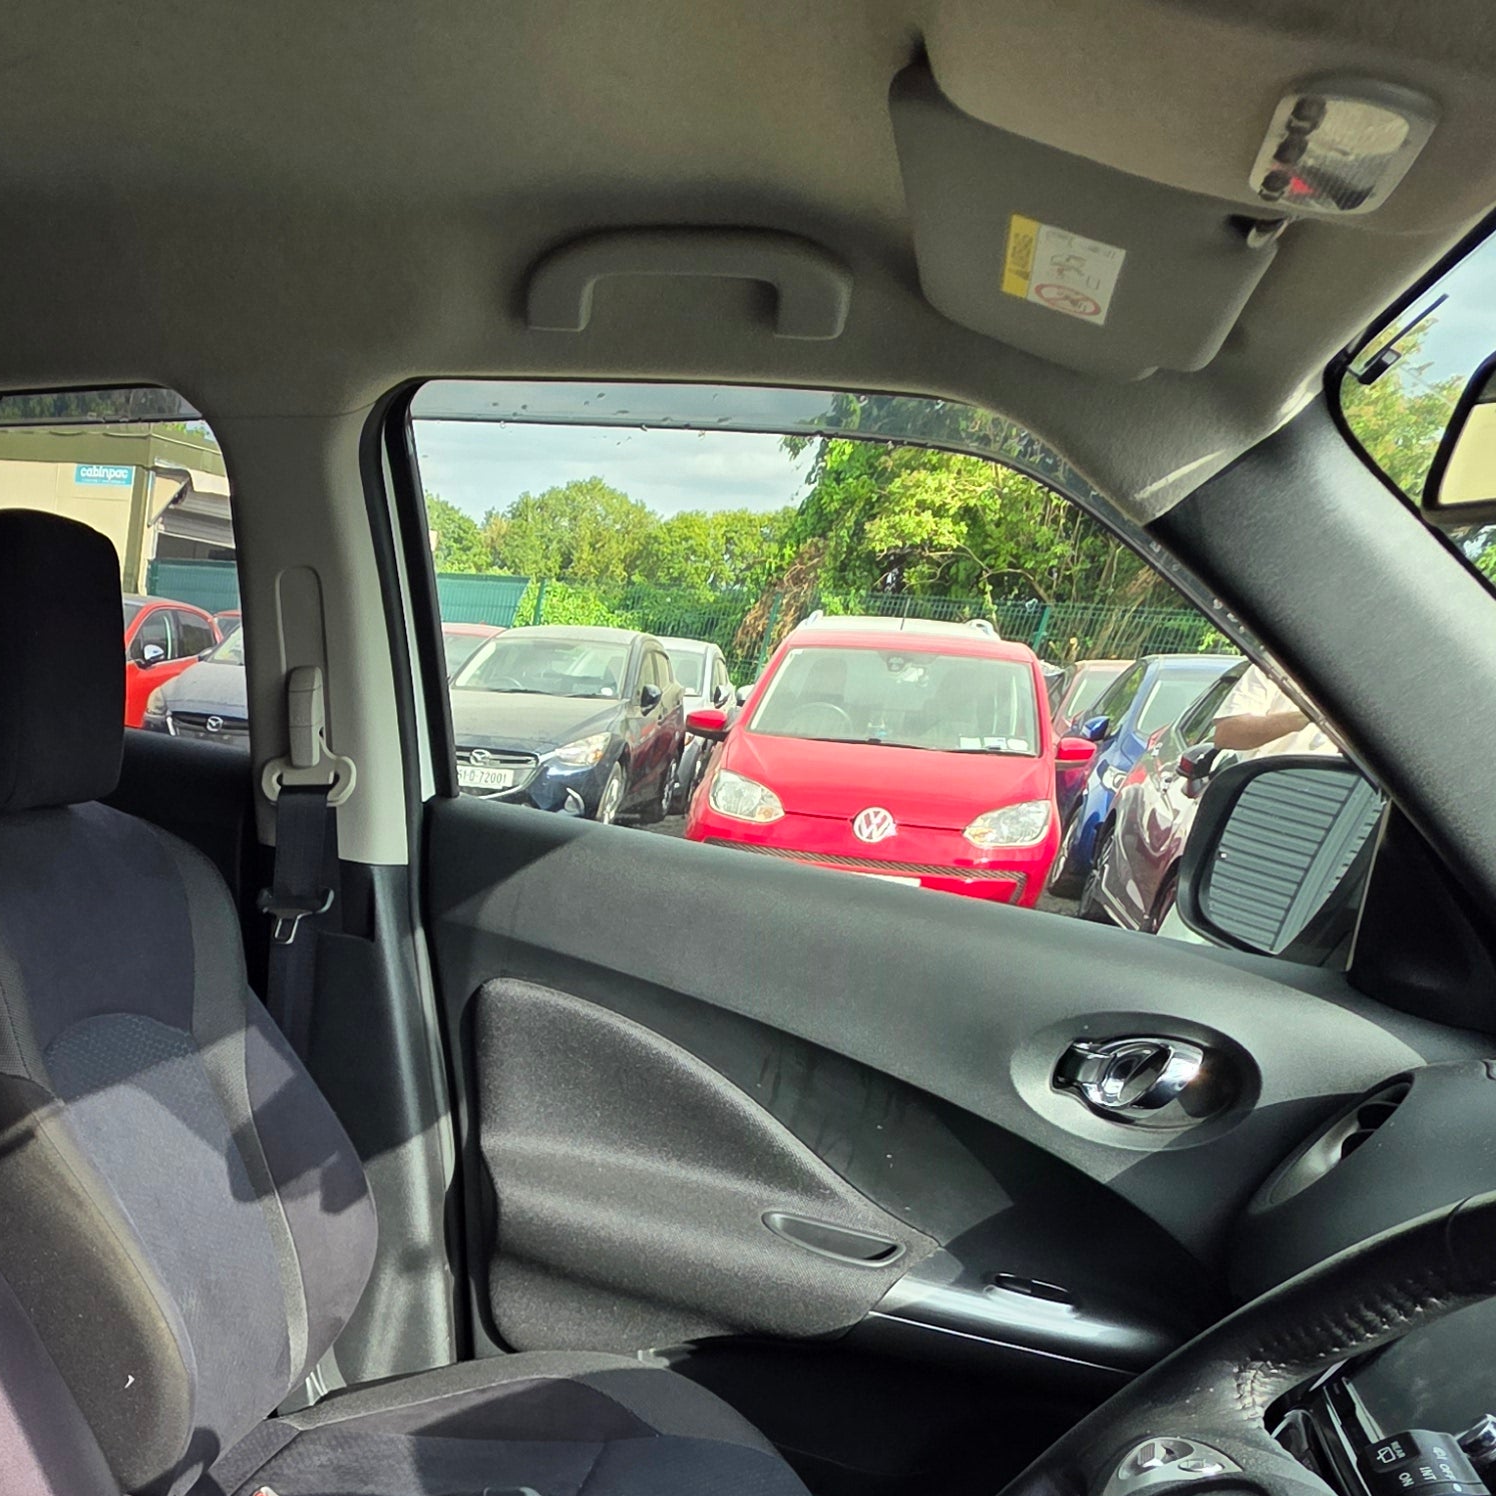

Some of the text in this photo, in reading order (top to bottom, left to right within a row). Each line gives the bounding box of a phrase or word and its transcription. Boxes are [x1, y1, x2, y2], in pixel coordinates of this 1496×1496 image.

[80, 465, 129, 480] cabinpac
[1398, 1472, 1415, 1487] ON
[1419, 1466, 1437, 1482] INT
